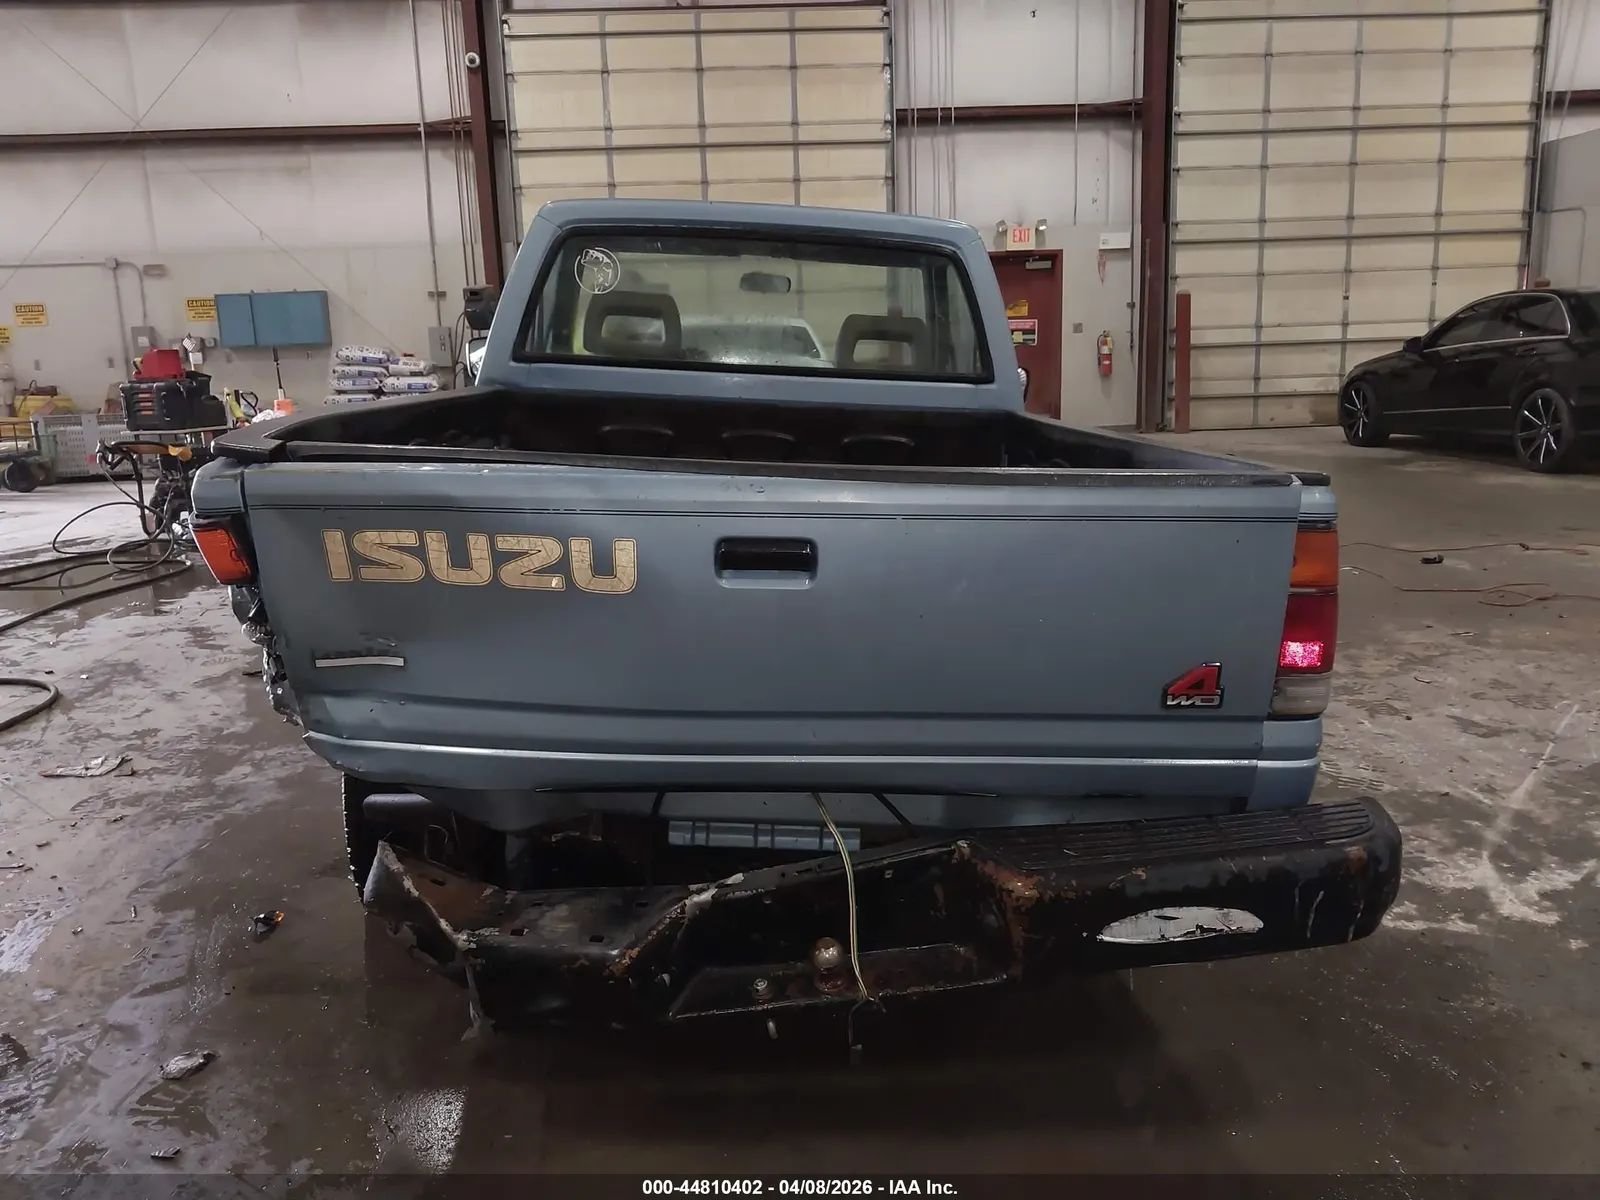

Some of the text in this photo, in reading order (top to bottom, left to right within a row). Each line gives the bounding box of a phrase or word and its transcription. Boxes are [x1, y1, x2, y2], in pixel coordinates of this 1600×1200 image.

[1012, 228, 1031, 243] EXIT
[321, 528, 638, 594] ISUZU
[1165, 662, 1221, 695] 4
[1166, 695, 1221, 706] WD
